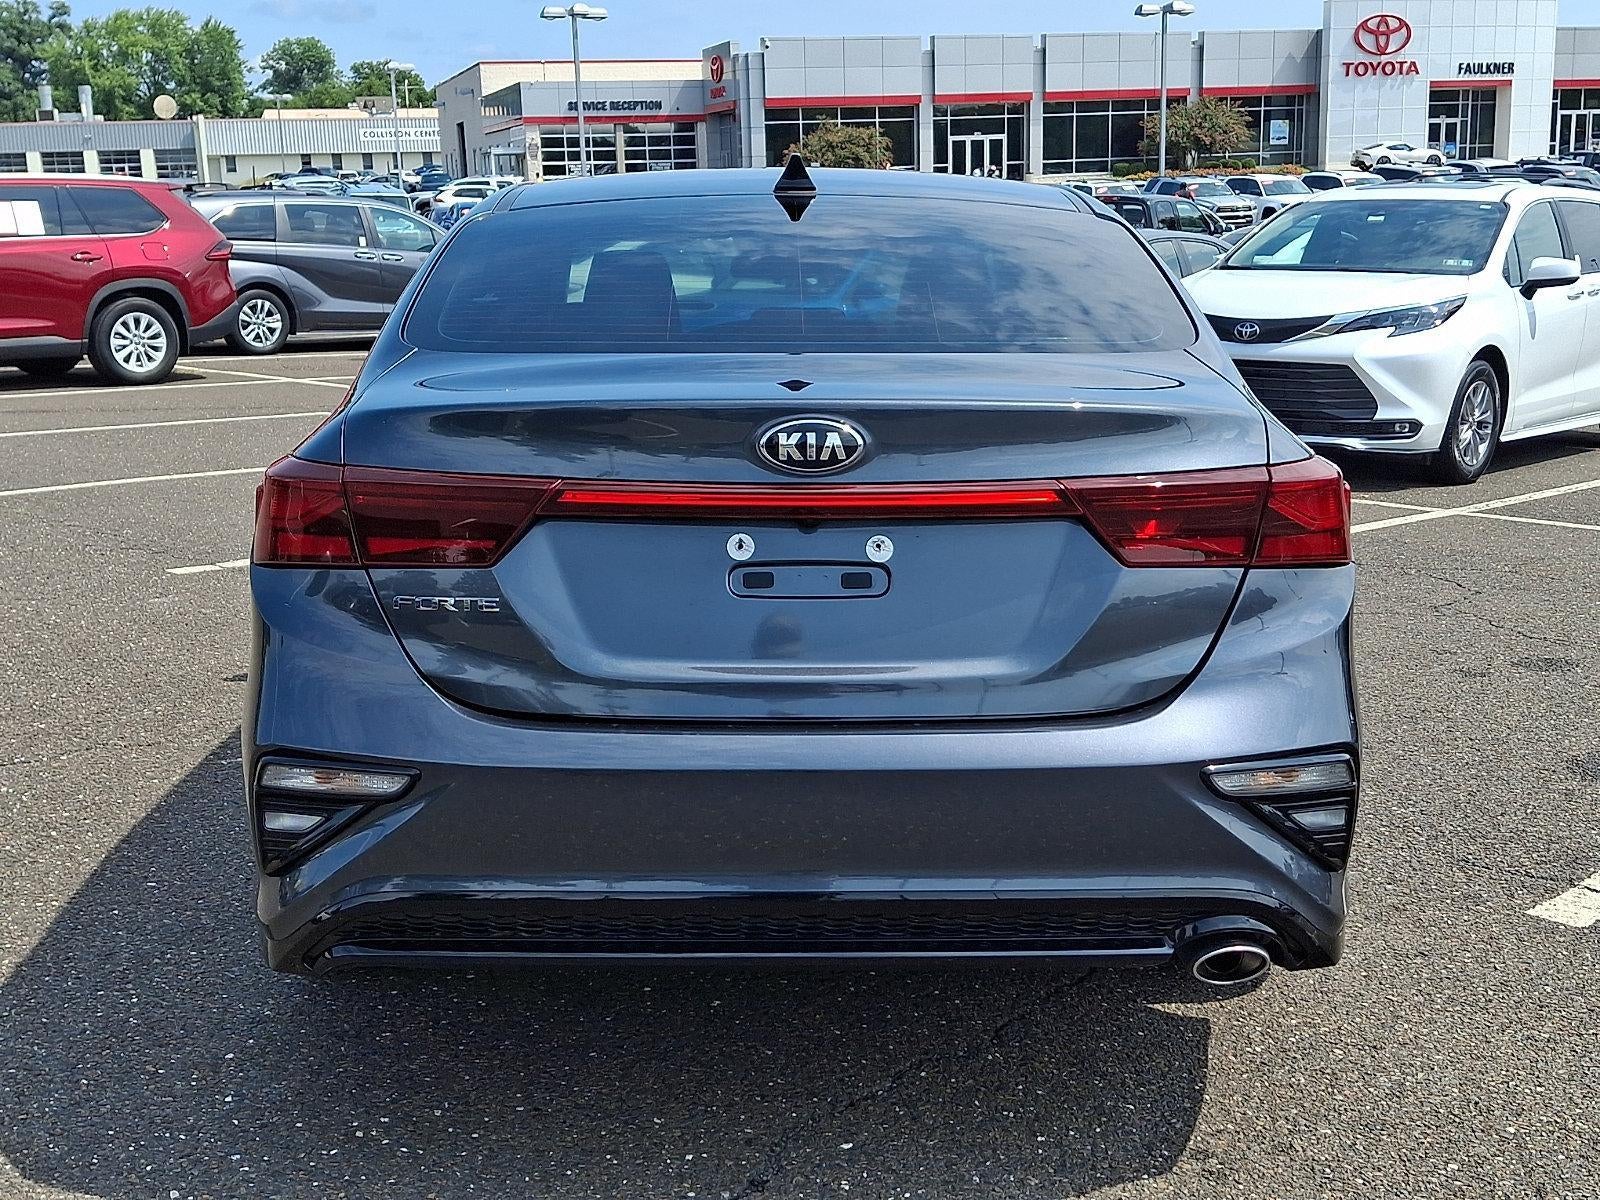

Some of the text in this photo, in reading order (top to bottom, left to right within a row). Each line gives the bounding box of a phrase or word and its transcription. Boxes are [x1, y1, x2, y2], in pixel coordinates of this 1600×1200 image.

[1342, 61, 1420, 77] TOYOTA
[1458, 62, 1515, 75] FAULKNER
[609, 100, 663, 111] RECEPTION
[777, 432, 847, 461] KIA
[393, 595, 500, 612] FORTE
